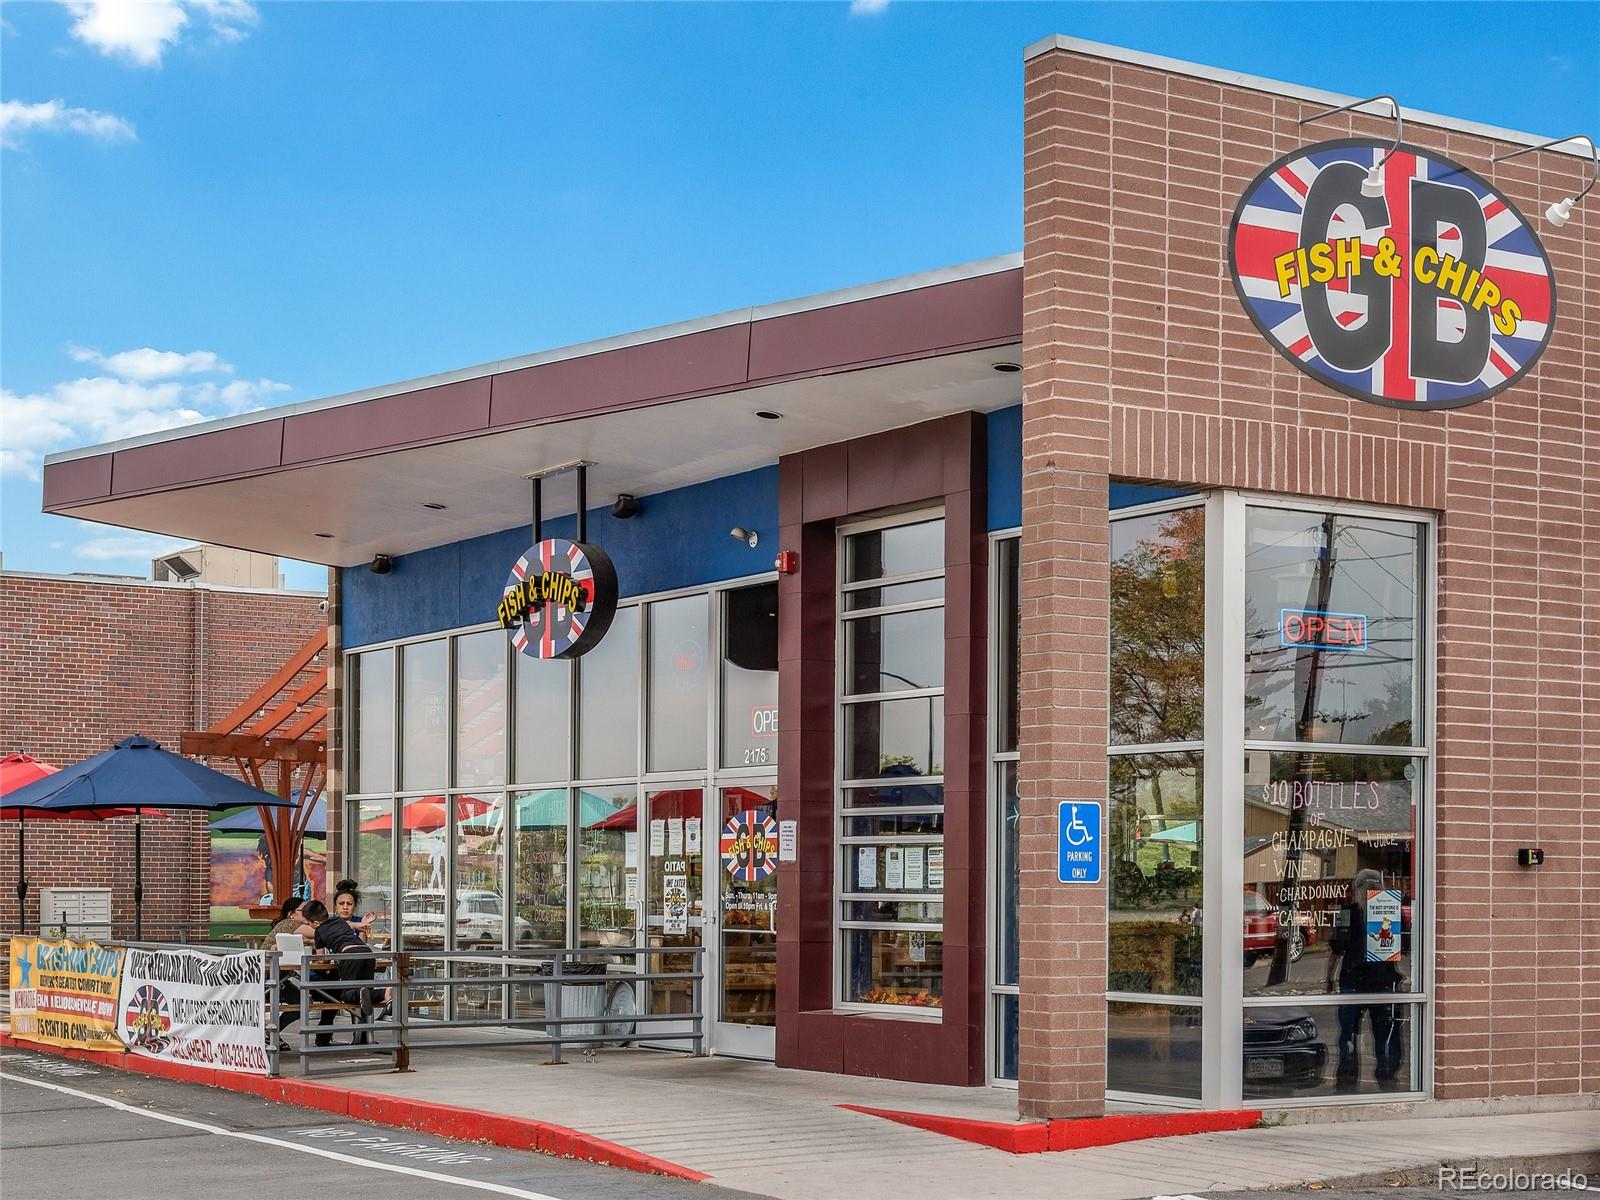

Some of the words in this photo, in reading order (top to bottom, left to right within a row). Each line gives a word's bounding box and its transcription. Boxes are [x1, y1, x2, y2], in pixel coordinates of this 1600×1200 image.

[1297, 160, 1491, 386] GB
[1273, 236, 1361, 300] FISH
[1372, 236, 1402, 278] &
[1413, 245, 1522, 337] CHIPS
[497, 581, 526, 630] FISH
[528, 574, 537, 602] &
[541, 571, 580, 613] CHIPS
[1284, 615, 1364, 646] OPEN
[753, 709, 778, 734] OPE
[744, 747, 766, 764] 2175
[1262, 780, 1288, 807] $10
[1292, 780, 1380, 811] BOTTLES
[1310, 813, 1326, 827] OF
[727, 837, 746, 859] FISH
[753, 834, 775, 857] CHIPS
[737, 823, 766, 869] GB
[1271, 829, 1355, 852] CHAMPAGNE
[1374, 832, 1399, 848] JUICE
[1066, 851, 1093, 862] PARKING
[1071, 868, 1088, 879] ONLY
[1279, 884, 1350, 903] CHARDONNAY
[725, 902, 738, 911] Open
[1279, 909, 1341, 928] CABERNET
[90, 946, 122, 978] CHIPS
[188, 1039, 213, 1064] AHEAD
